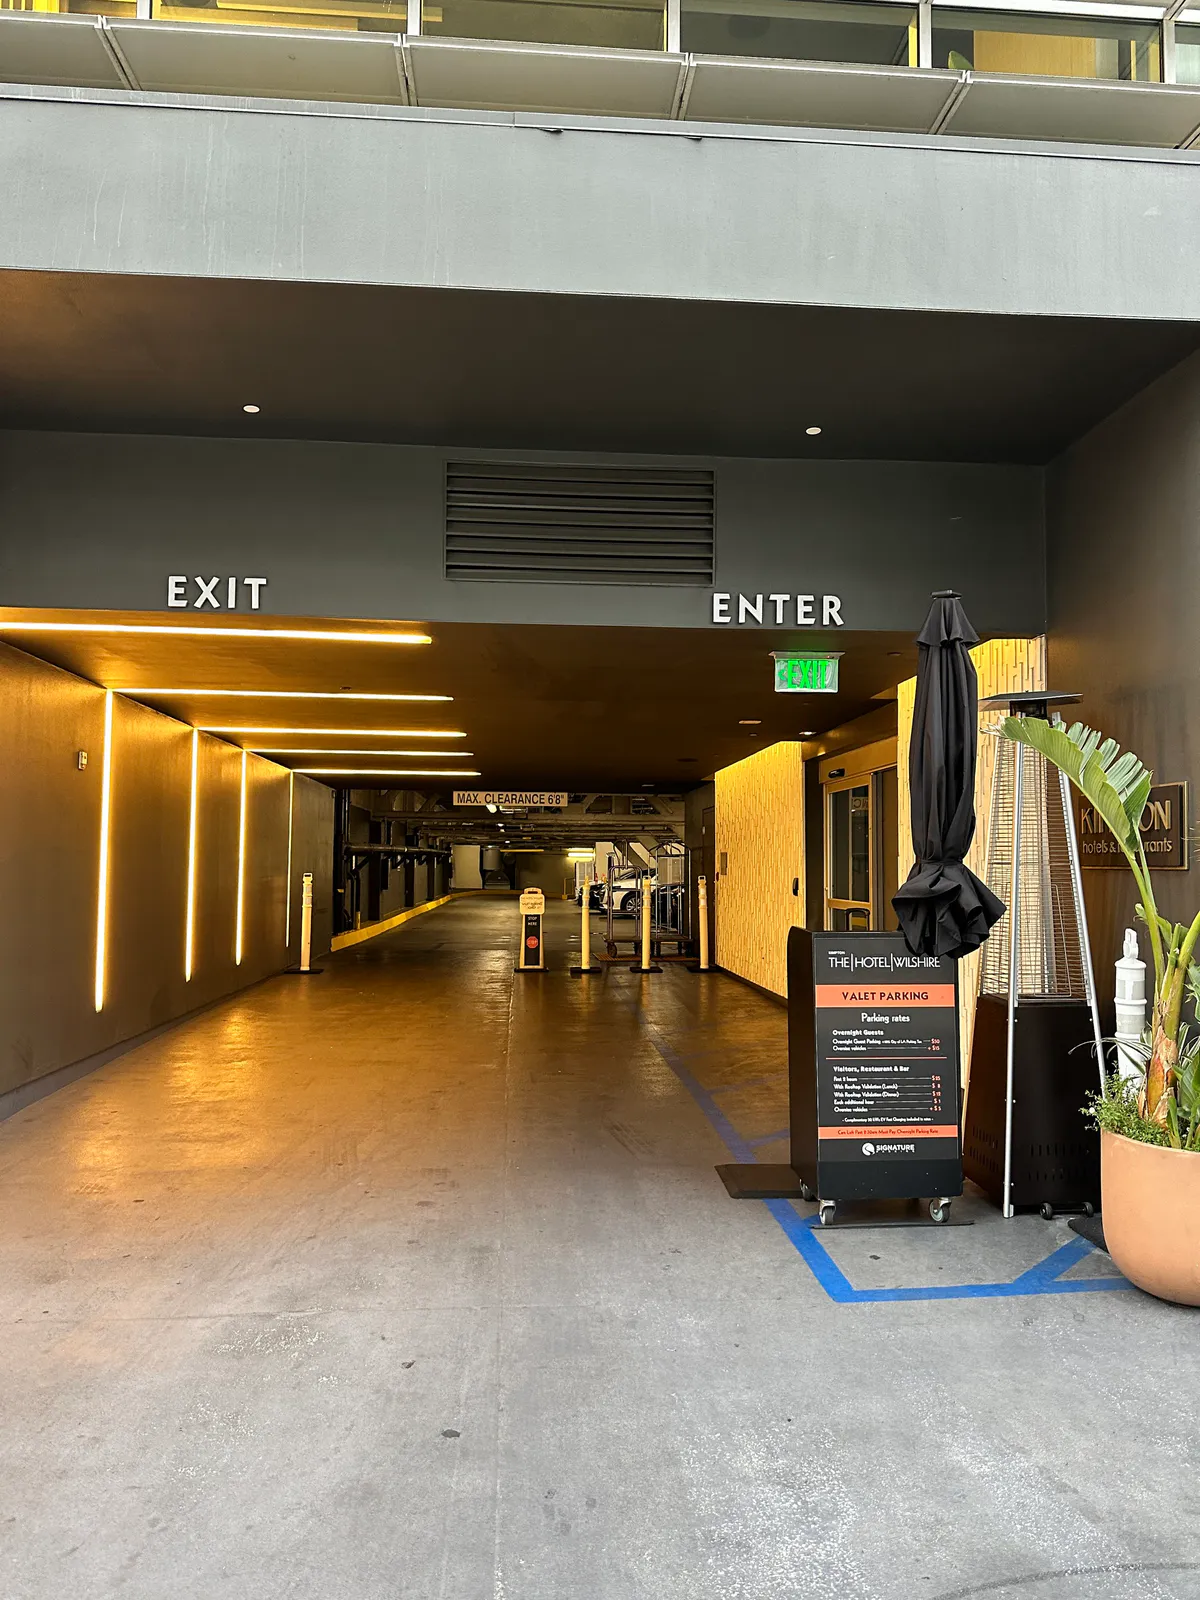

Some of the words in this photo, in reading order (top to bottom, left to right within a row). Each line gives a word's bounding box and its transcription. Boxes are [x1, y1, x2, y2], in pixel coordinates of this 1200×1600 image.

[168, 576, 266, 609] EXIT
[712, 593, 844, 626] ENTER
[787, 660, 828, 689] EXIT
[457, 793, 481, 804] MAX.
[484, 794, 544, 804] CLEARANCE
[548, 794, 564, 804] 6'8"
[1081, 800, 1171, 834] KION
[1082, 840, 1108, 853] hotels
[1109, 842, 1116, 853] &
[828, 957, 850, 967] THE
[855, 957, 890, 967] HOTEL
[893, 957, 940, 967] WILSHIRE
[842, 992, 876, 1000] VALET
[880, 992, 928, 1000] PARKING
[861, 1013, 889, 1024] Parking
